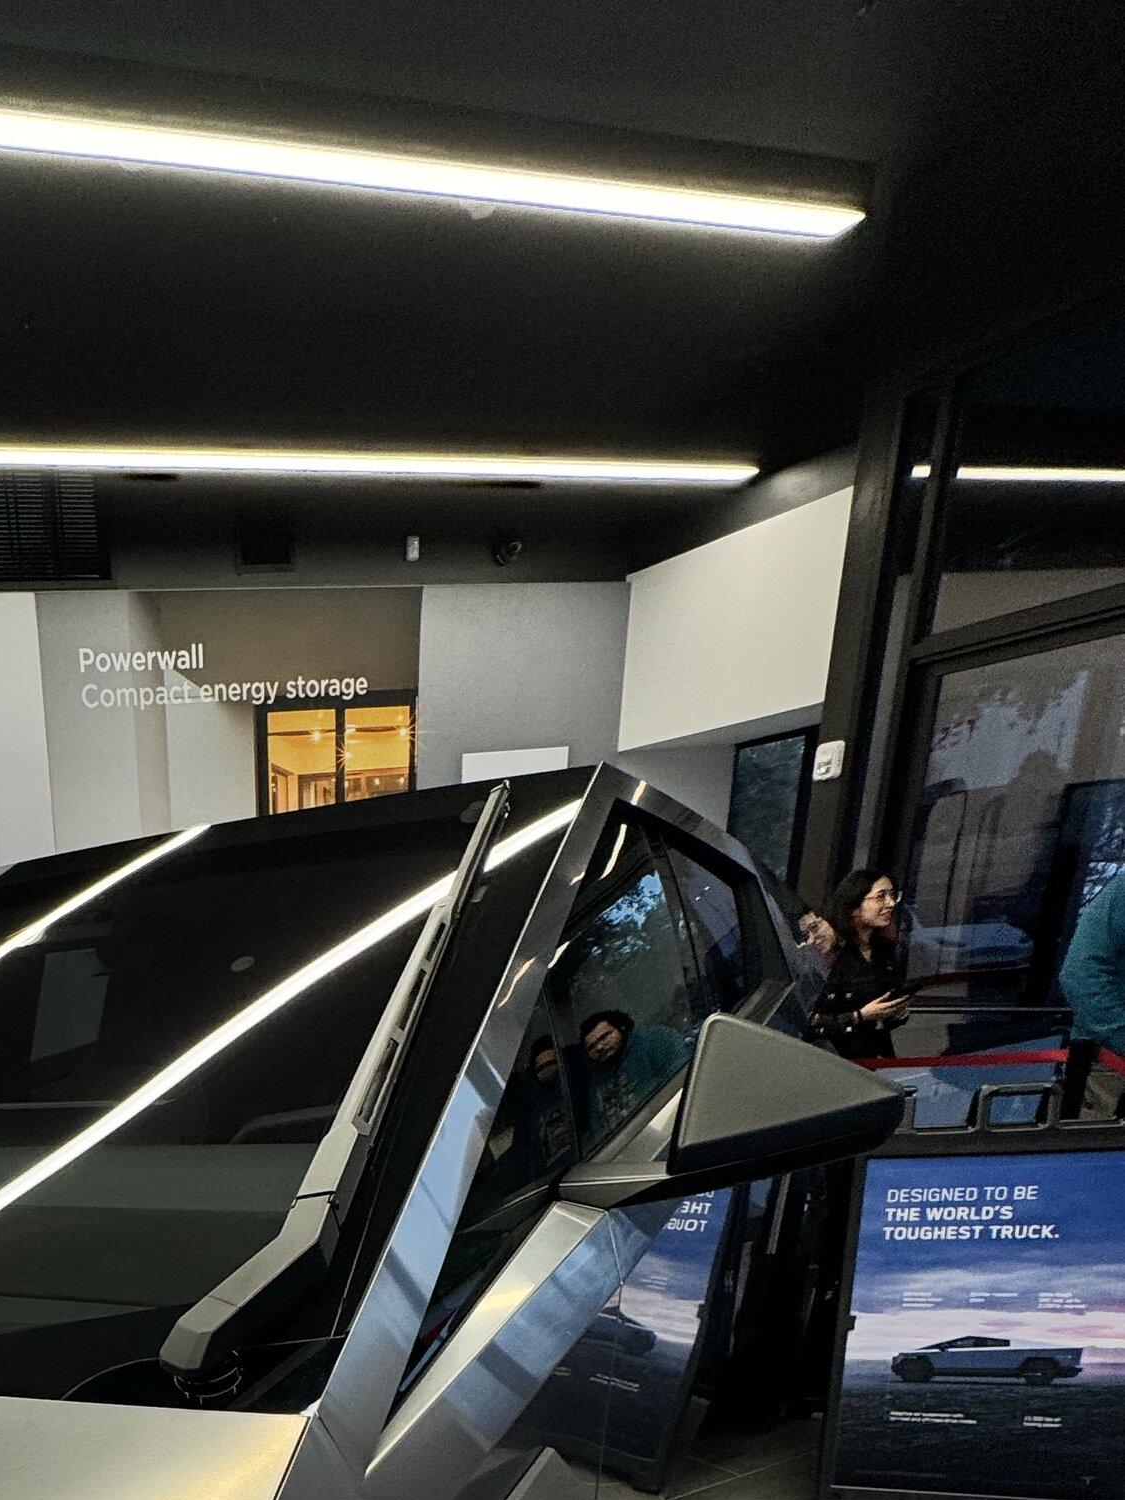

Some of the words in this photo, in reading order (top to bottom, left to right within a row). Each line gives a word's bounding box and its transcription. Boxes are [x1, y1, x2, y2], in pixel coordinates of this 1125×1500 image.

[78, 643, 204, 673] Powerwall
[81, 682, 192, 710] Compact
[199, 680, 280, 704] energy
[285, 675, 369, 701] storage
[886, 1187, 978, 1204] DESIGNED
[984, 1186, 1008, 1201] TO
[1013, 1185, 1039, 1201] BE
[885, 1207, 922, 1222] THE
[925, 1205, 1014, 1221] WORLD'S
[883, 1225, 985, 1241] TOUGHEST
[988, 1224, 1061, 1239] TRUCK.
